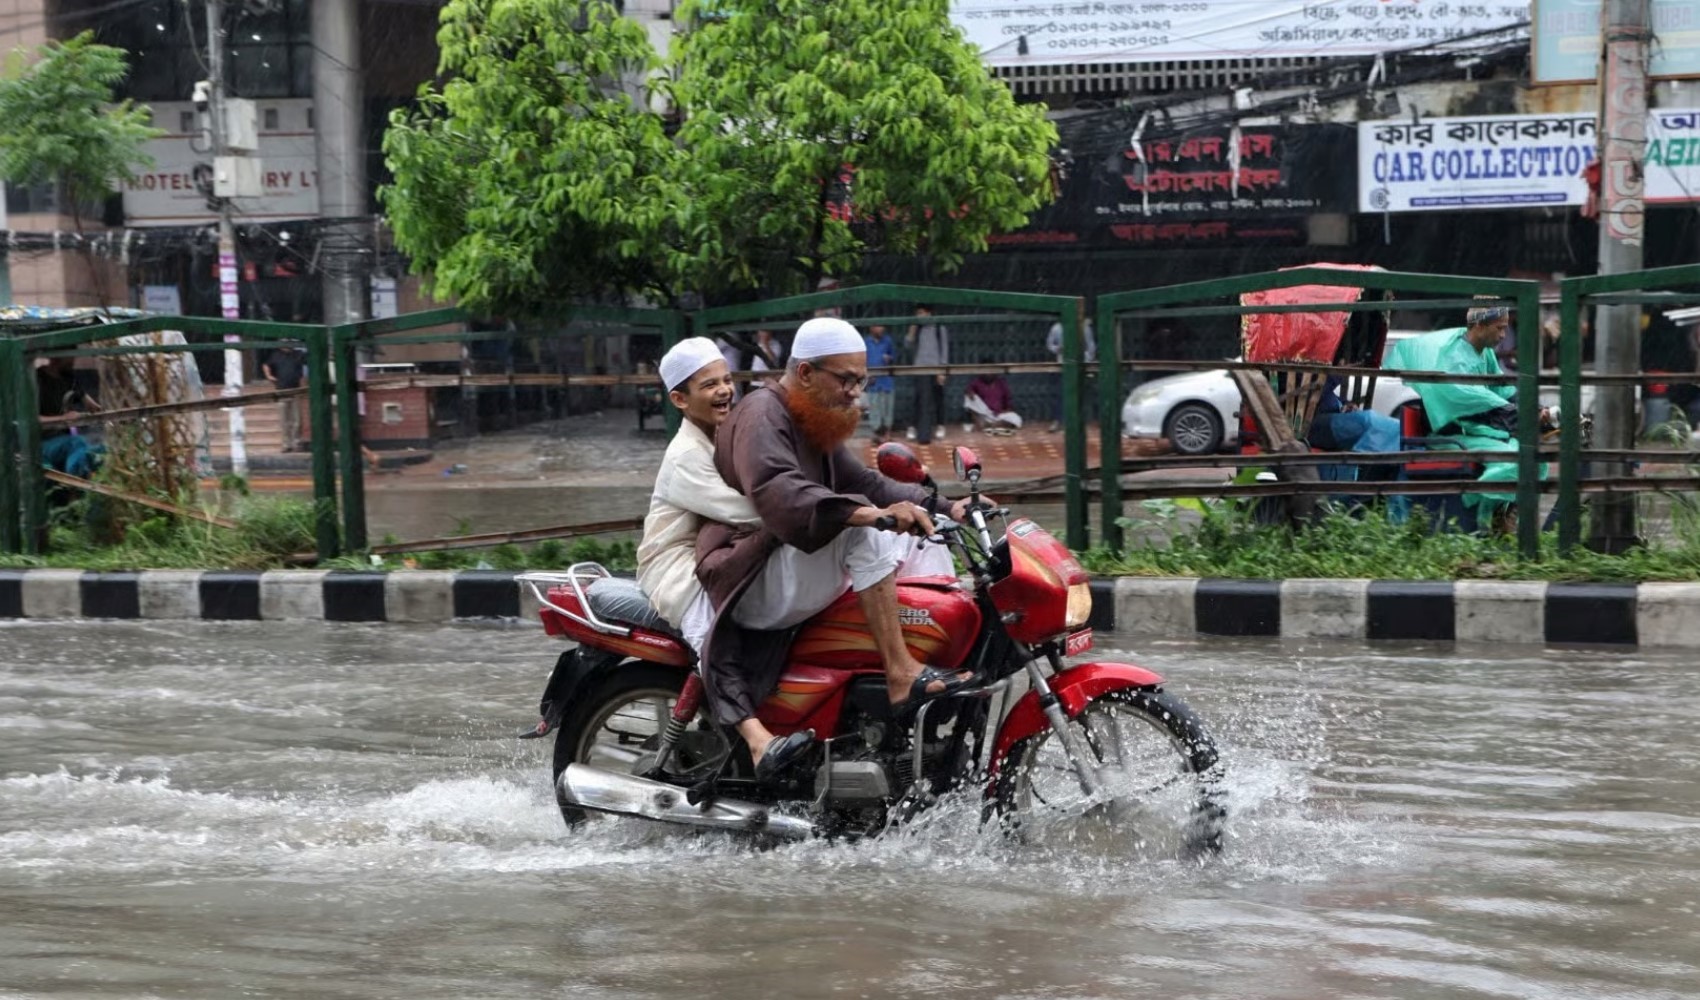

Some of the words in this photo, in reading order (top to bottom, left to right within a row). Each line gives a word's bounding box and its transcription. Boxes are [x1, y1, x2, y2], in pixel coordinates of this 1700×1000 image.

[1374, 123, 1434, 148] কার
[1445, 117, 1596, 146] কালেকশন
[1373, 151, 1426, 183] CAR
[1644, 138, 1700, 167] ABI
[897, 609, 929, 617] ERO
[901, 617, 935, 626] NDA
